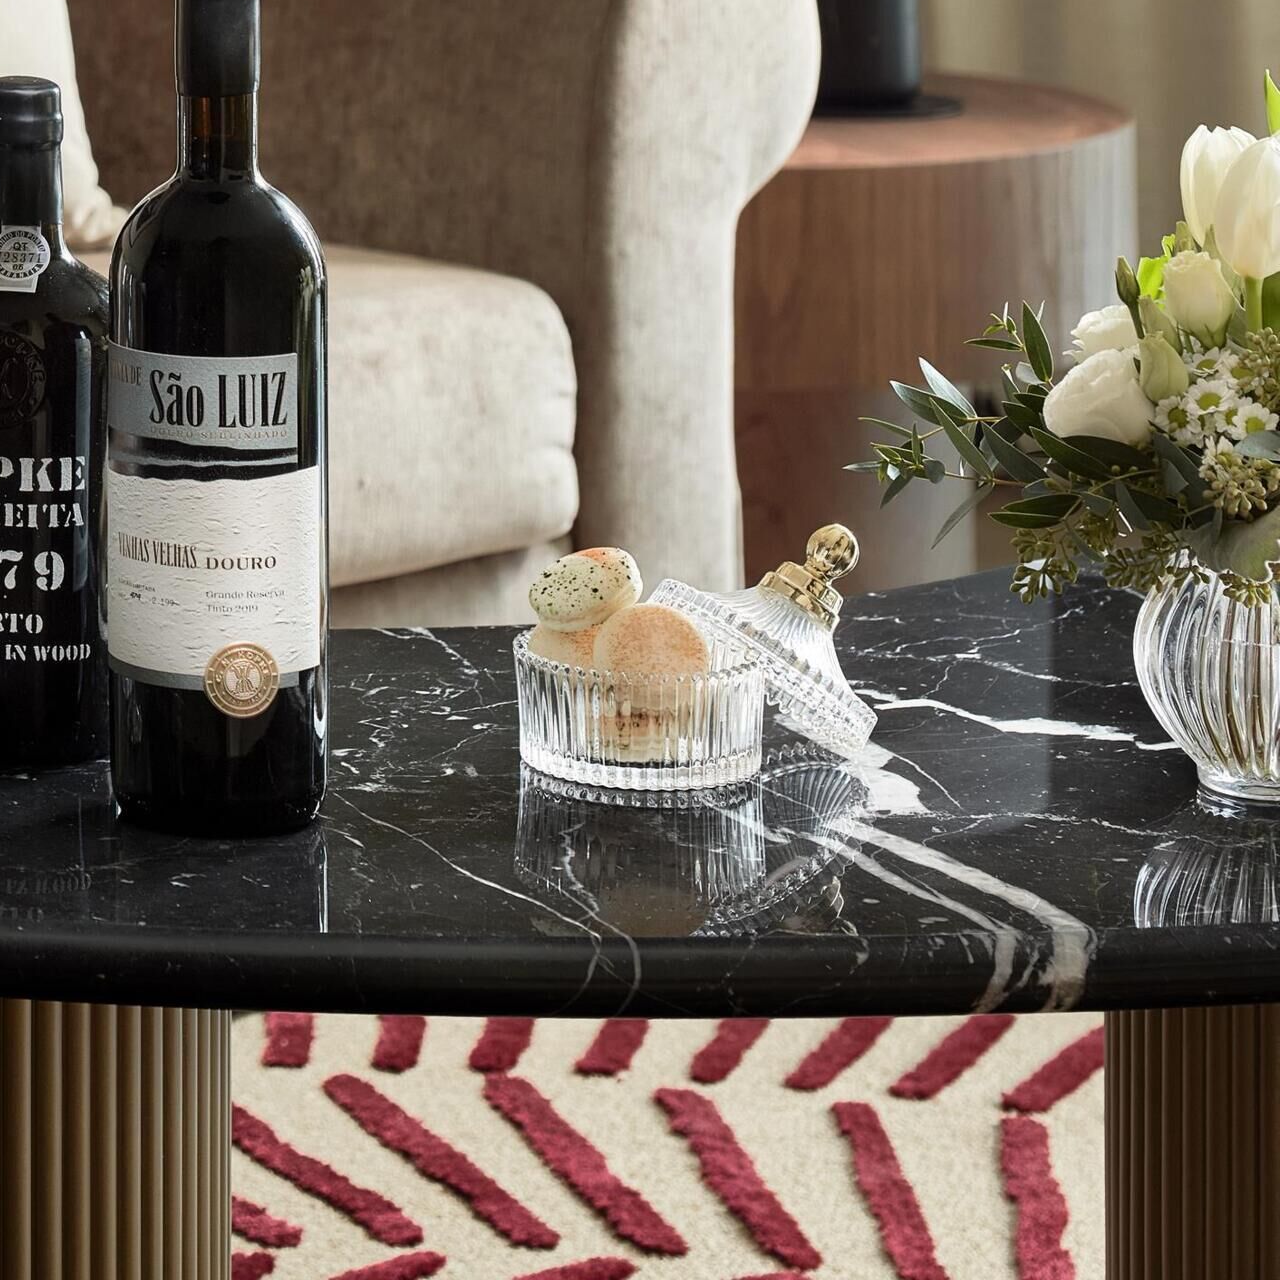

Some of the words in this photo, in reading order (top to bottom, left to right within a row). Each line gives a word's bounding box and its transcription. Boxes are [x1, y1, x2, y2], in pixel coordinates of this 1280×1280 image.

[149, 370, 204, 427] São
[218, 371, 288, 428] LUIZ
[117, 531, 150, 563] VINHAS
[152, 539, 198, 569] VELHAS
[206, 555, 277, 571] DOURO
[205, 590, 243, 599] Grande
[5, 644, 27, 661] IN
[33, 643, 91, 662] WOOD
